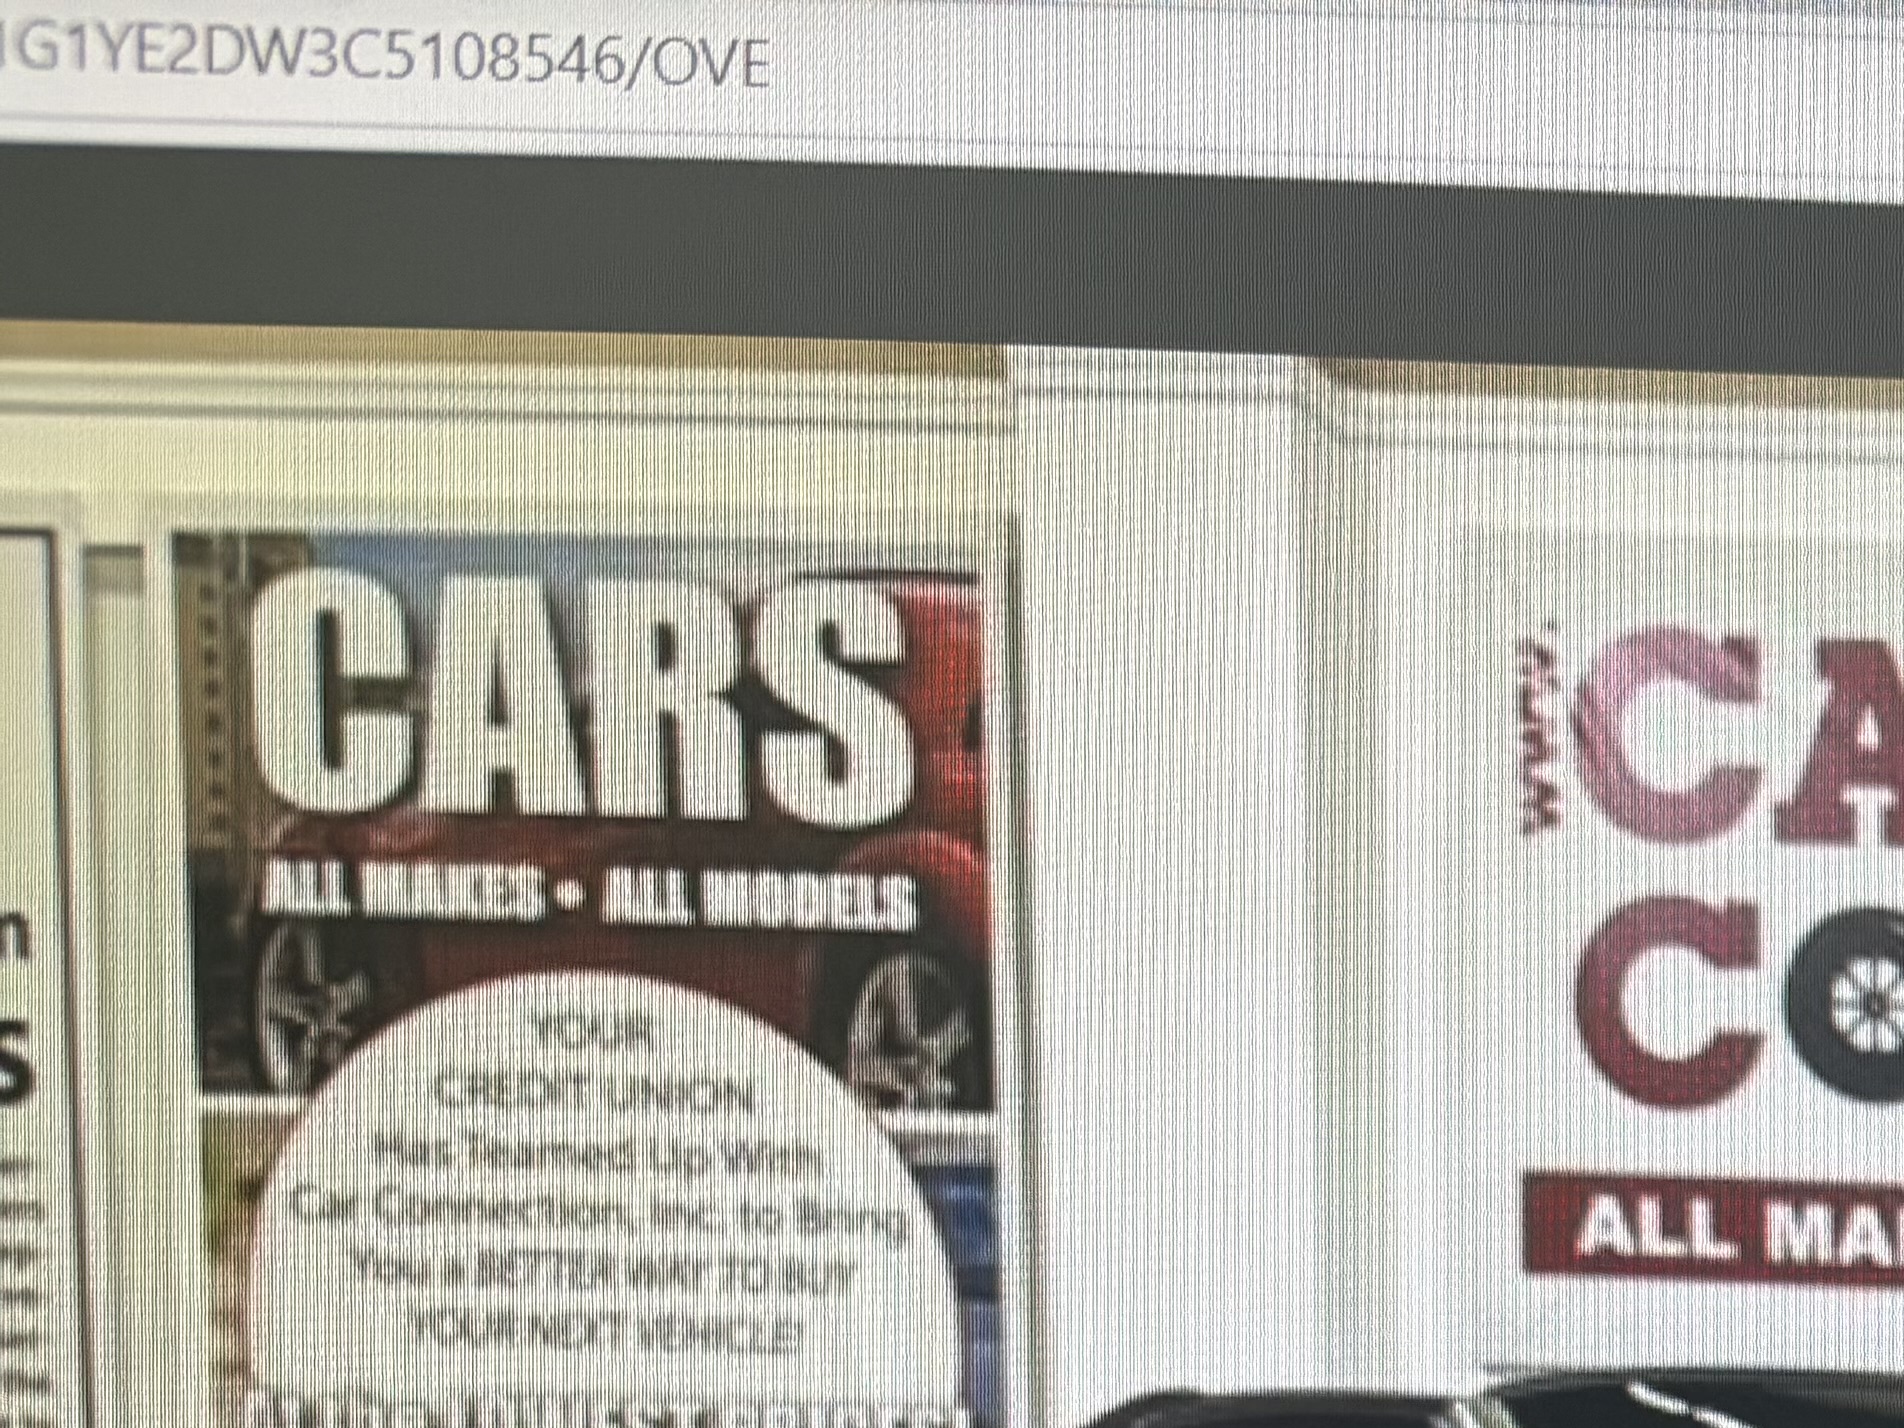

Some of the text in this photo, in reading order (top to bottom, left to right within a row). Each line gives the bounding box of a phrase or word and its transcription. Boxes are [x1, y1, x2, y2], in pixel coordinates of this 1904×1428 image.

[252, 567, 914, 829] CARS
[261, 859, 917, 931] ALL MAKES ALL MODELS
[529, 1009, 654, 1050] YOUR
[432, 1070, 753, 1115] CREDIT UNION
[373, 1130, 822, 1183] Has Teamed Up With
[290, 1186, 909, 1248] Car Connection, Inc. to Bring
[1579, 1195, 1737, 1261] ALL
[349, 1251, 855, 1297] You a BETTER WAY TO BUY
[408, 1310, 804, 1355] YOUR NEXT VEHICLE!
